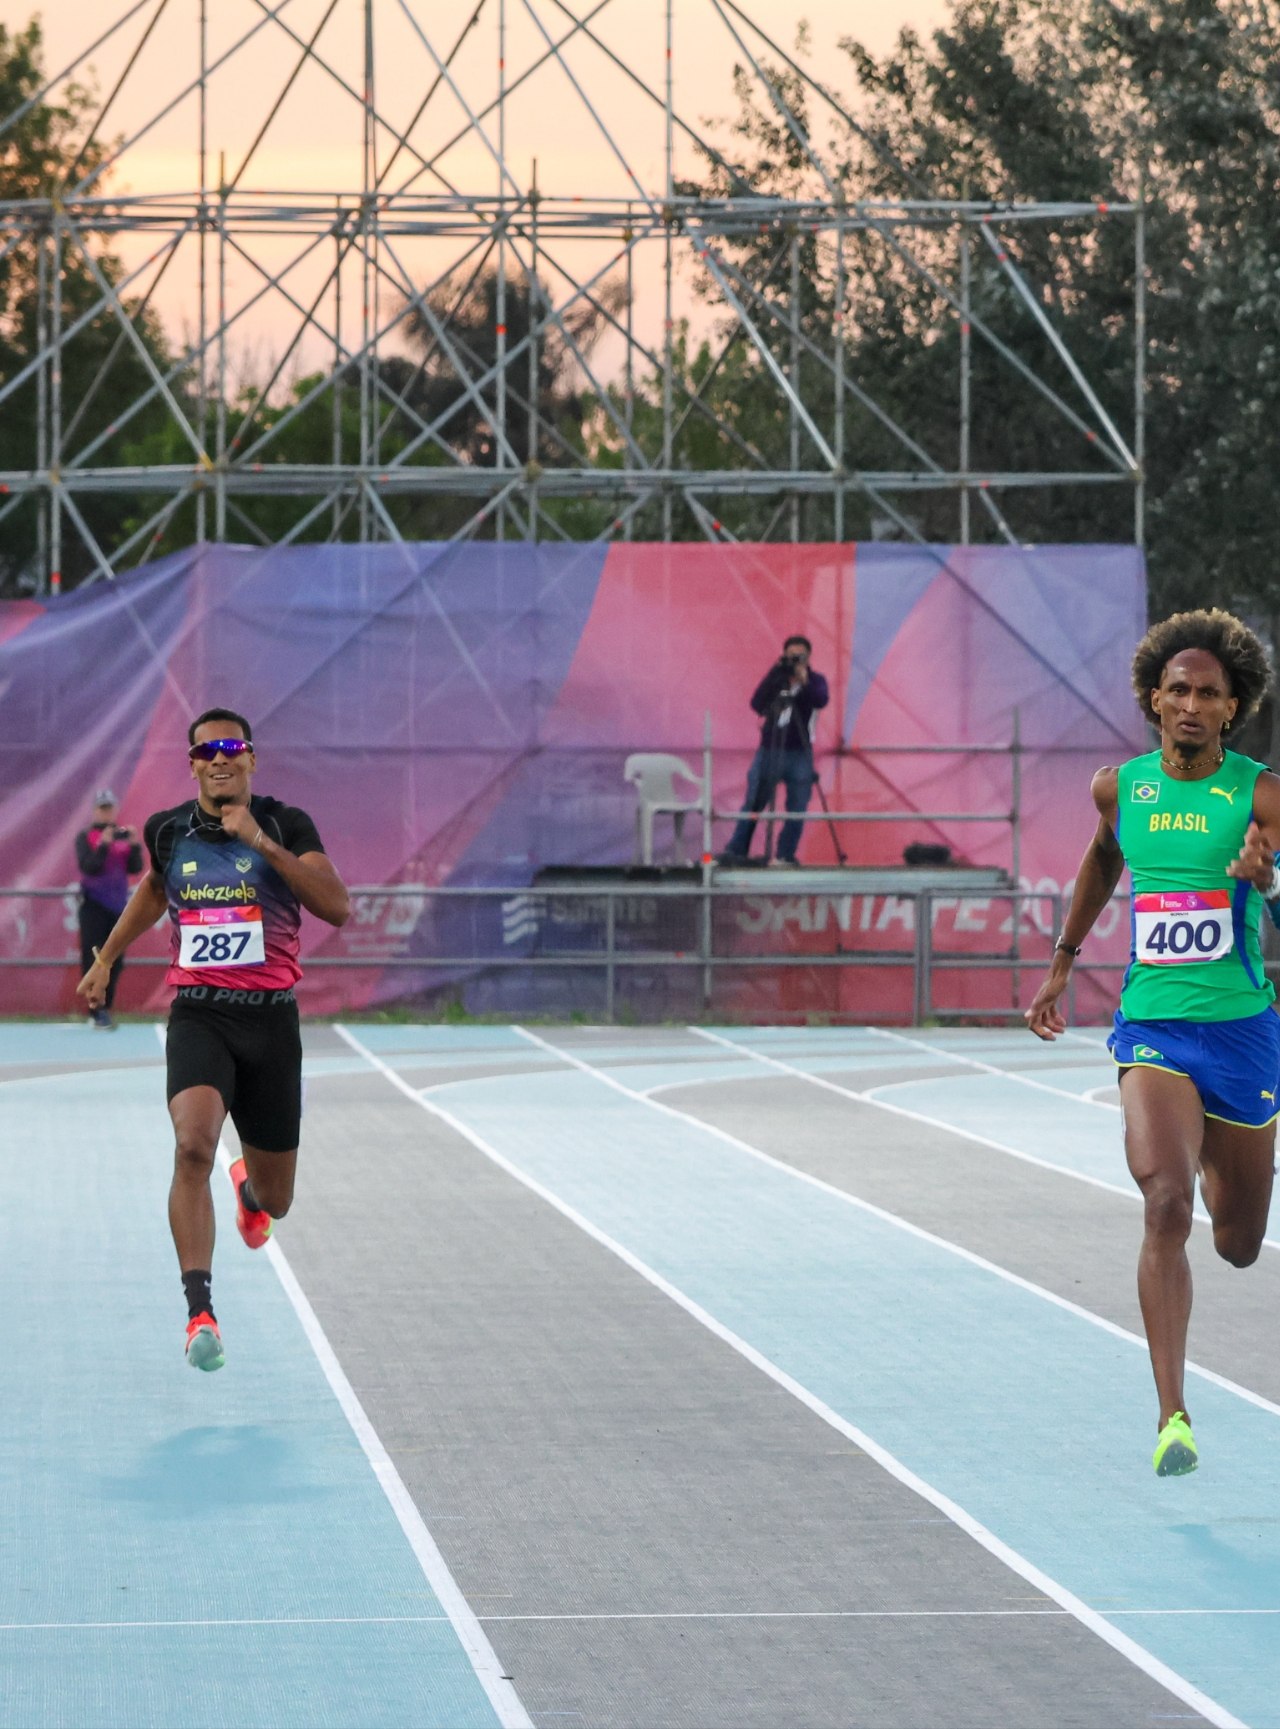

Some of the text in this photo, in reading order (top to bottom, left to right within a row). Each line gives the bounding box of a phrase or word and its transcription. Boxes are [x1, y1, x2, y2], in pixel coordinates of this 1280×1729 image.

[1149, 813, 1209, 833] BRASIL
[191, 931, 251, 963] 287
[1145, 919, 1221, 954] 400
[214, 988, 265, 1005] PRO
